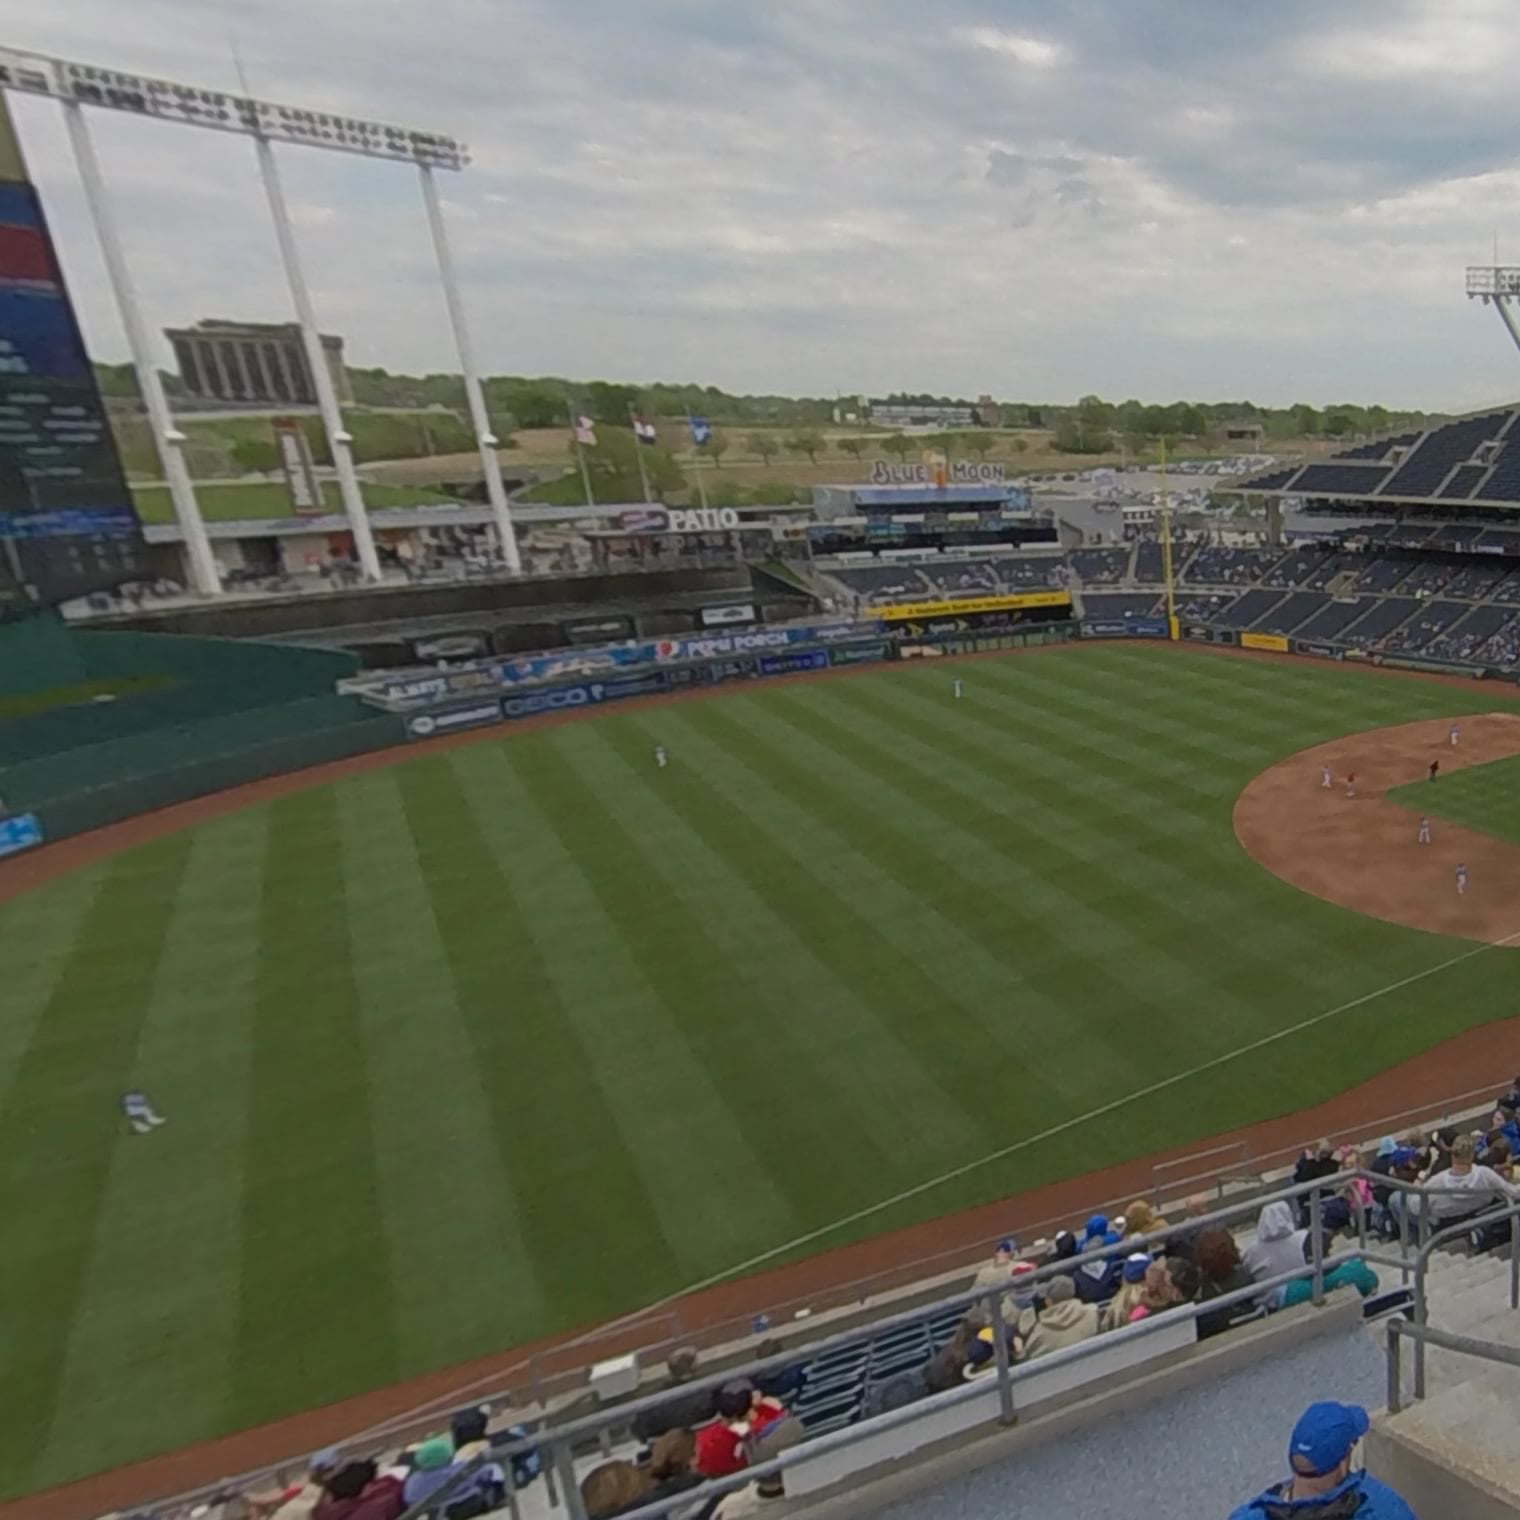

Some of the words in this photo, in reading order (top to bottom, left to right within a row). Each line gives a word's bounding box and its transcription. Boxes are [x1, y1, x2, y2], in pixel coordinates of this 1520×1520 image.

[872, 460, 928, 484] BLUE
[951, 463, 1005, 479] MOON
[668, 507, 739, 531] PATIO
[734, 631, 789, 649] PORCH
[504, 687, 588, 715] GEICO
